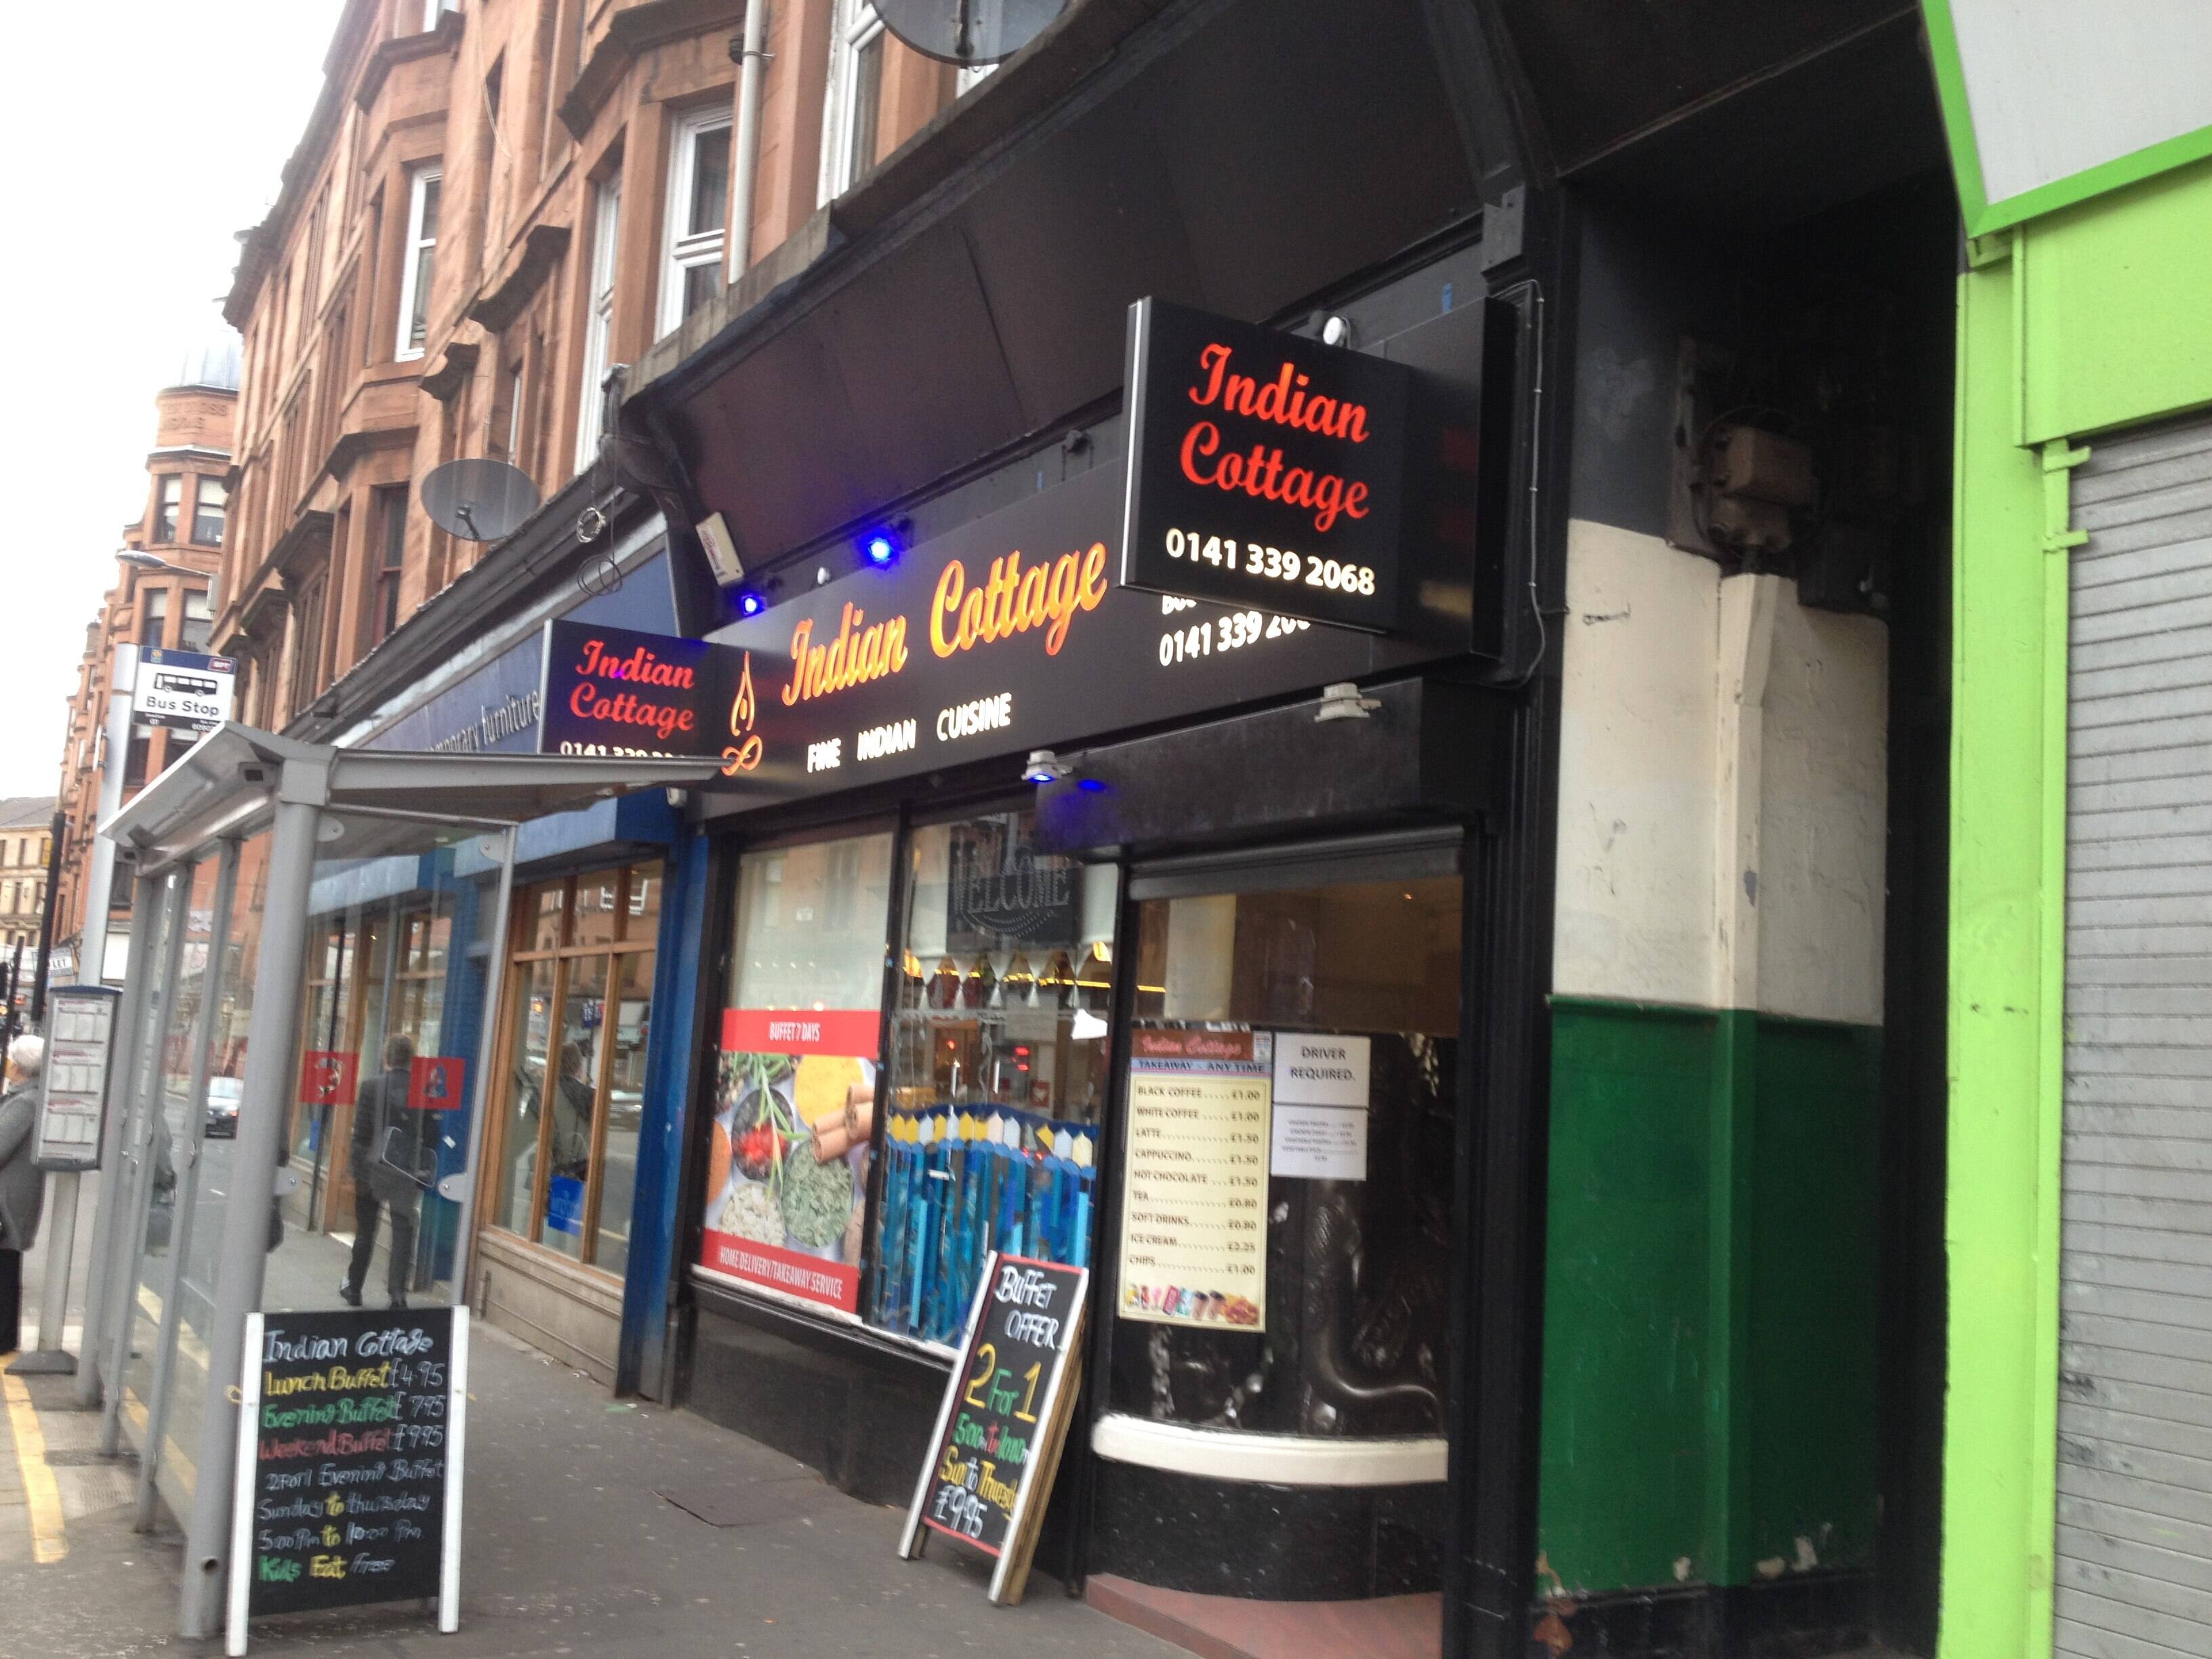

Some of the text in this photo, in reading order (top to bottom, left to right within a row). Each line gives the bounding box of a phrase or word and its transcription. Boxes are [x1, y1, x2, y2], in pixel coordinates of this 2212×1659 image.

[1189, 344, 1371, 443] Indian
[1181, 421, 1370, 532] Cottage
[1166, 528, 1376, 596] 0141 339 2068
[782, 542, 1107, 706] Indian Cottage
[1160, 622, 1211, 666] 0141
[1217, 611, 1263, 651] 339
[575, 640, 694, 689] Indian
[146, 696, 176, 710] Bus
[182, 701, 219, 717] Stop
[481, 690, 539, 745] furniture
[569, 682, 694, 739] Cottage
[808, 693, 1012, 773] FINE INDIAN CUISINE
[52, 959, 66, 968] LET
[769, 1022, 820, 1042] BUFFET 7 DAYS
[1139, 1061, 1265, 1073] TAKEAWAY ANY TIME
[1300, 1045, 1346, 1060] DRIVER
[1138, 1086, 1164, 1097] BLACK
[1231, 1090, 1260, 1101] £1.00
[1137, 1107, 1162, 1117] WHITE
[1166, 1109, 1199, 1119] COFFEE
[1136, 1128, 1161, 1138] LATTE
[1135, 1149, 1192, 1162] CAPPUCCINO
[1134, 1170, 1151, 1181] HOT
[1153, 1171, 1208, 1185] CHOCOLATE
[1131, 1212, 1153, 1222] SOFT
[1156, 1214, 1189, 1226] DRINKS
[1130, 1233, 1144, 1244] ICE
[1147, 1234, 1177, 1247] CREAM
[720, 1246, 739, 1269] HOME
[811, 1273, 843, 1300] SERVICE
[1130, 1255, 1155, 1267] CHIPS
[994, 1265, 1057, 1311] BUFFET
[263, 1329, 348, 1364] Indian
[1004, 1309, 1060, 1350] OFFER
[265, 1371, 327, 1397] Lunch
[327, 1360, 391, 1390] Buffet
[964, 1343, 1042, 1424] 2 For 1
[263, 1403, 337, 1429] Evening
[337, 1395, 396, 1424] Buffet
[259, 1429, 337, 1461] Weekend
[337, 1427, 392, 1455] Buffet
[318, 1462, 387, 1488] Evening
[387, 1458, 445, 1483] Buffet
[939, 1444, 968, 1486] Sun
[258, 1497, 324, 1521] Sunday
[325, 1491, 345, 1517] to
[258, 1553, 396, 1583] Kids Eat Free
